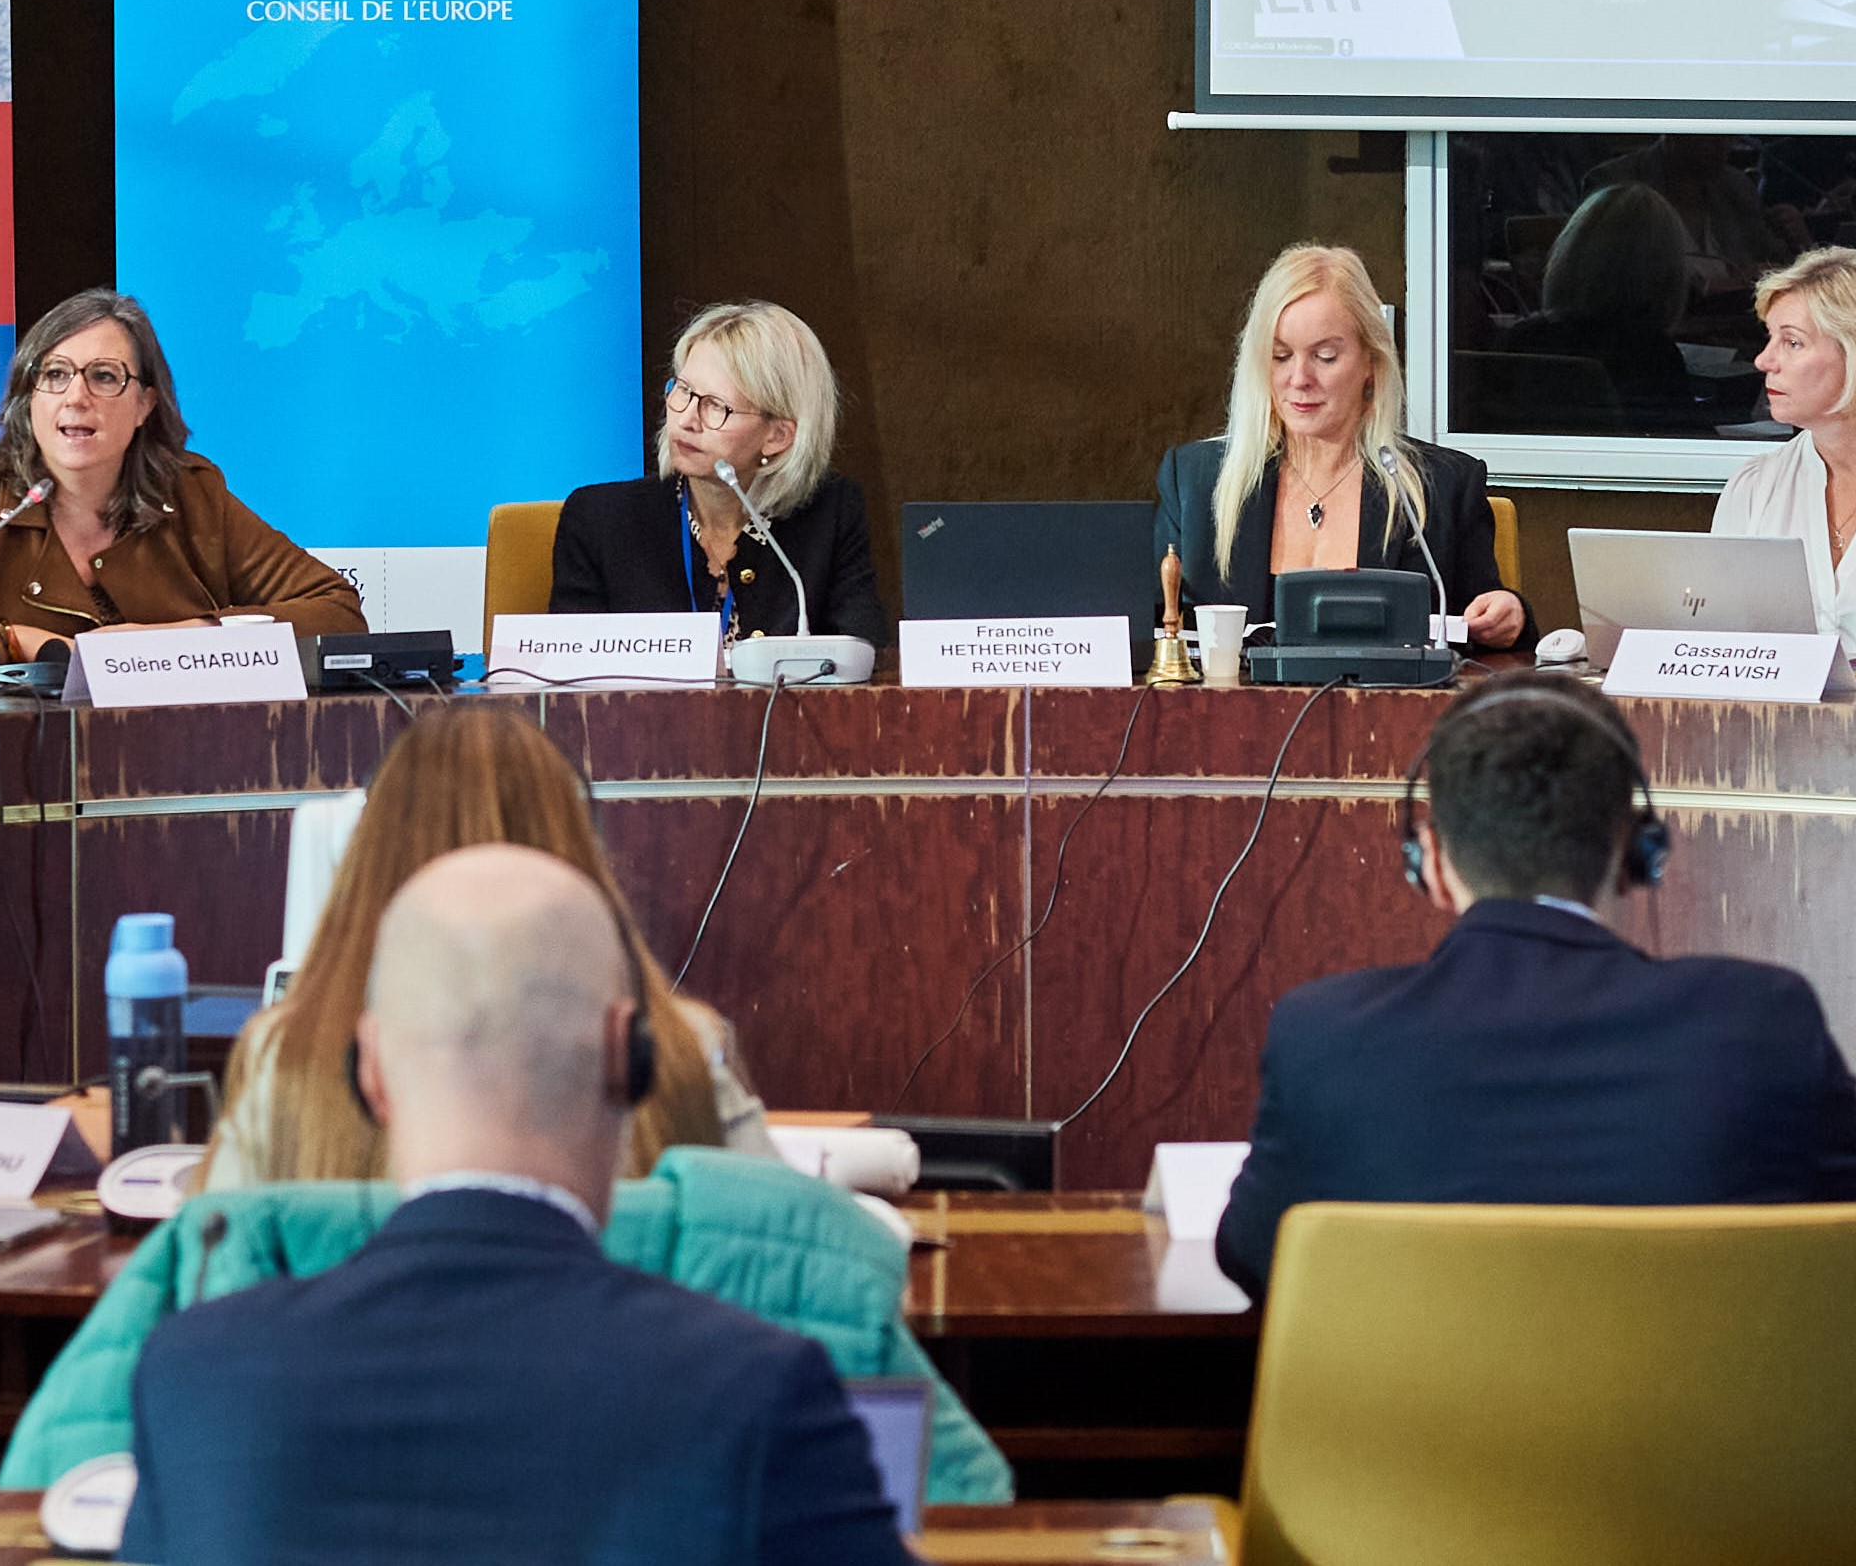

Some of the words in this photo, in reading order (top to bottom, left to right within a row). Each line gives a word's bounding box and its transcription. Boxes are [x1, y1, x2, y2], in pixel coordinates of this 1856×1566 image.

[246, 0, 354, 21] CONSEIL
[362, 0, 393, 21] DE
[403, 0, 513, 21] L'EUROPE
[976, 625, 1054, 637] Francine
[519, 639, 583, 653] Hanne
[590, 639, 692, 653] JUNCHER
[941, 643, 1091, 656] HETHERINGTON
[1674, 642, 1777, 660] Cassandra
[105, 652, 172, 675] Solène
[178, 650, 279, 671] CHARUAU
[972, 661, 1062, 673] RAVENEY
[1657, 662, 1781, 680] MACTAVISH
